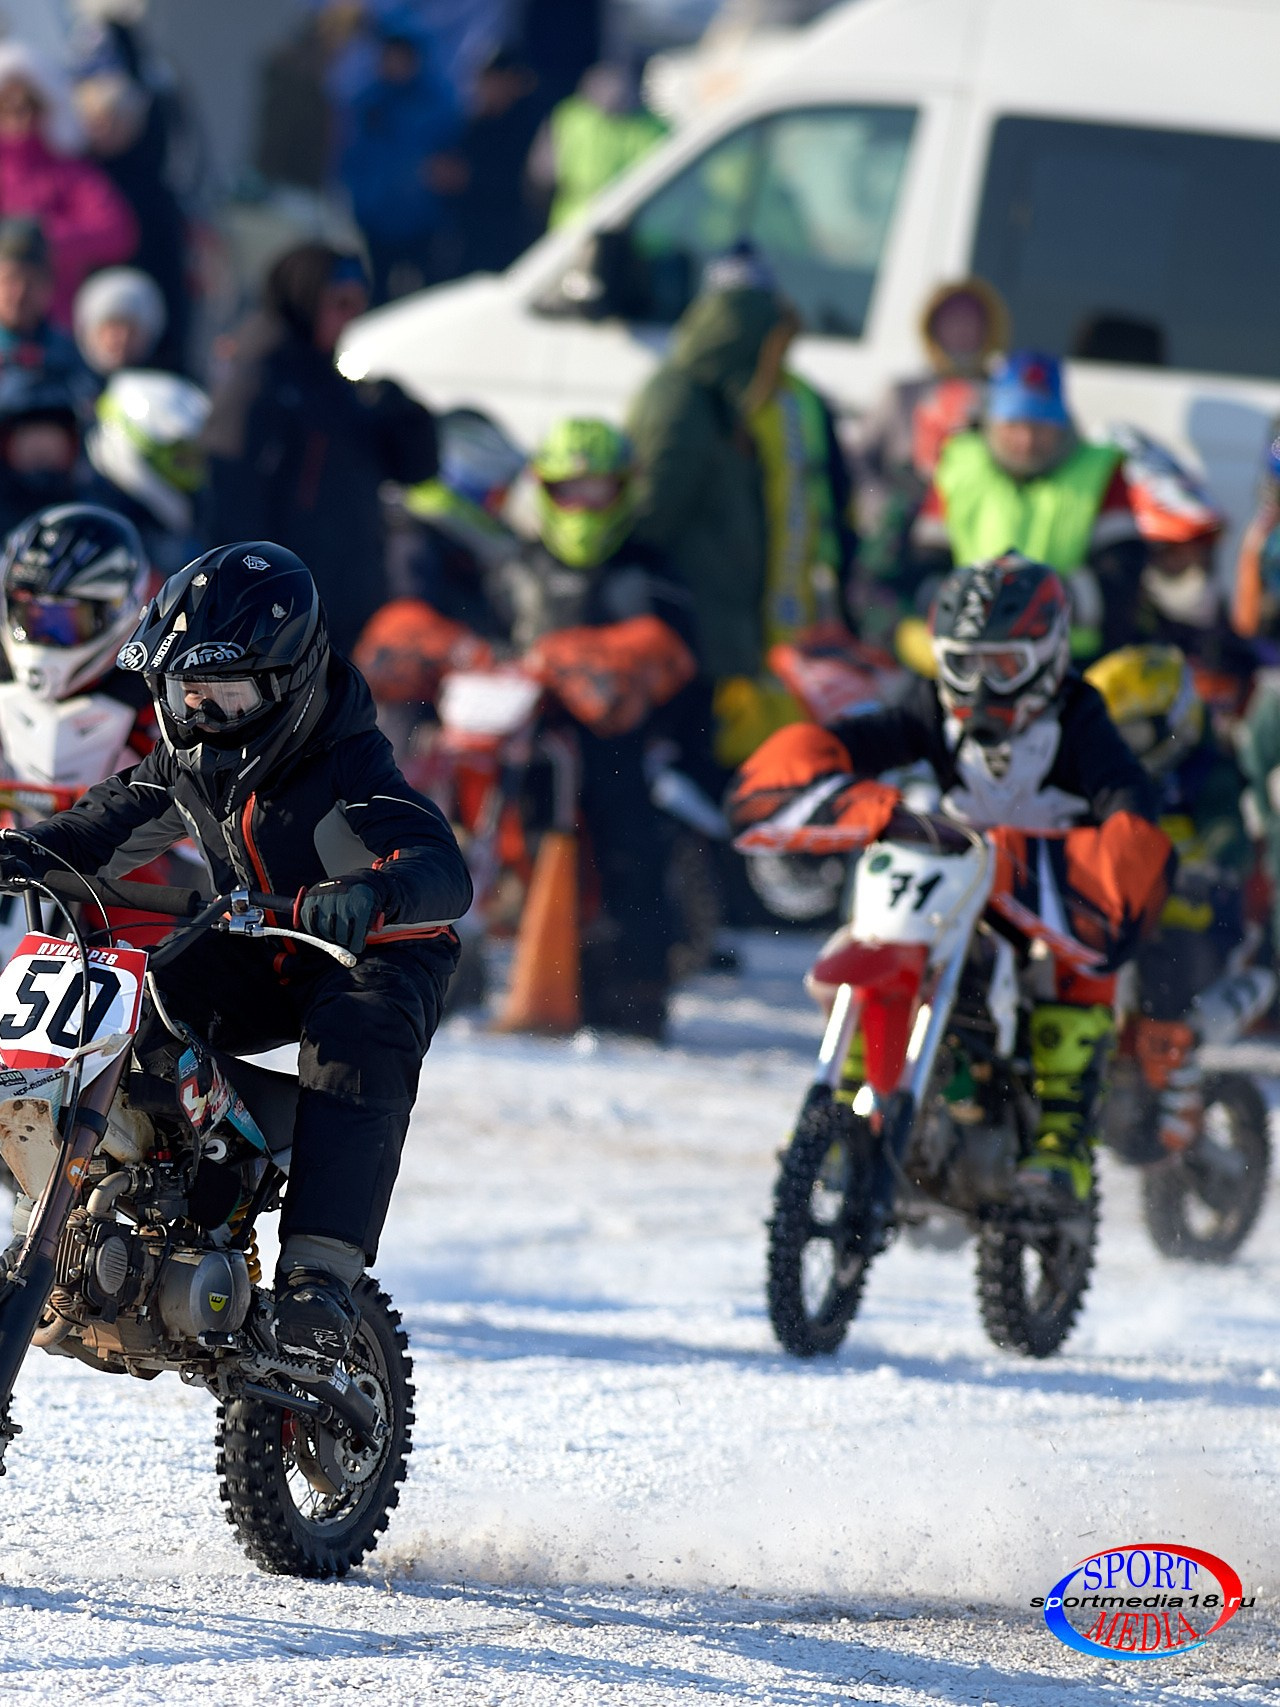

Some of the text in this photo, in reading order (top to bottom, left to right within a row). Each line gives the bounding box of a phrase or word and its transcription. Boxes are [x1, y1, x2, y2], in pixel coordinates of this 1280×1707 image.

[182, 646, 238, 670] Airoh
[889, 871, 942, 912] 71
[37, 942, 119, 966] ПУШКРЕВ
